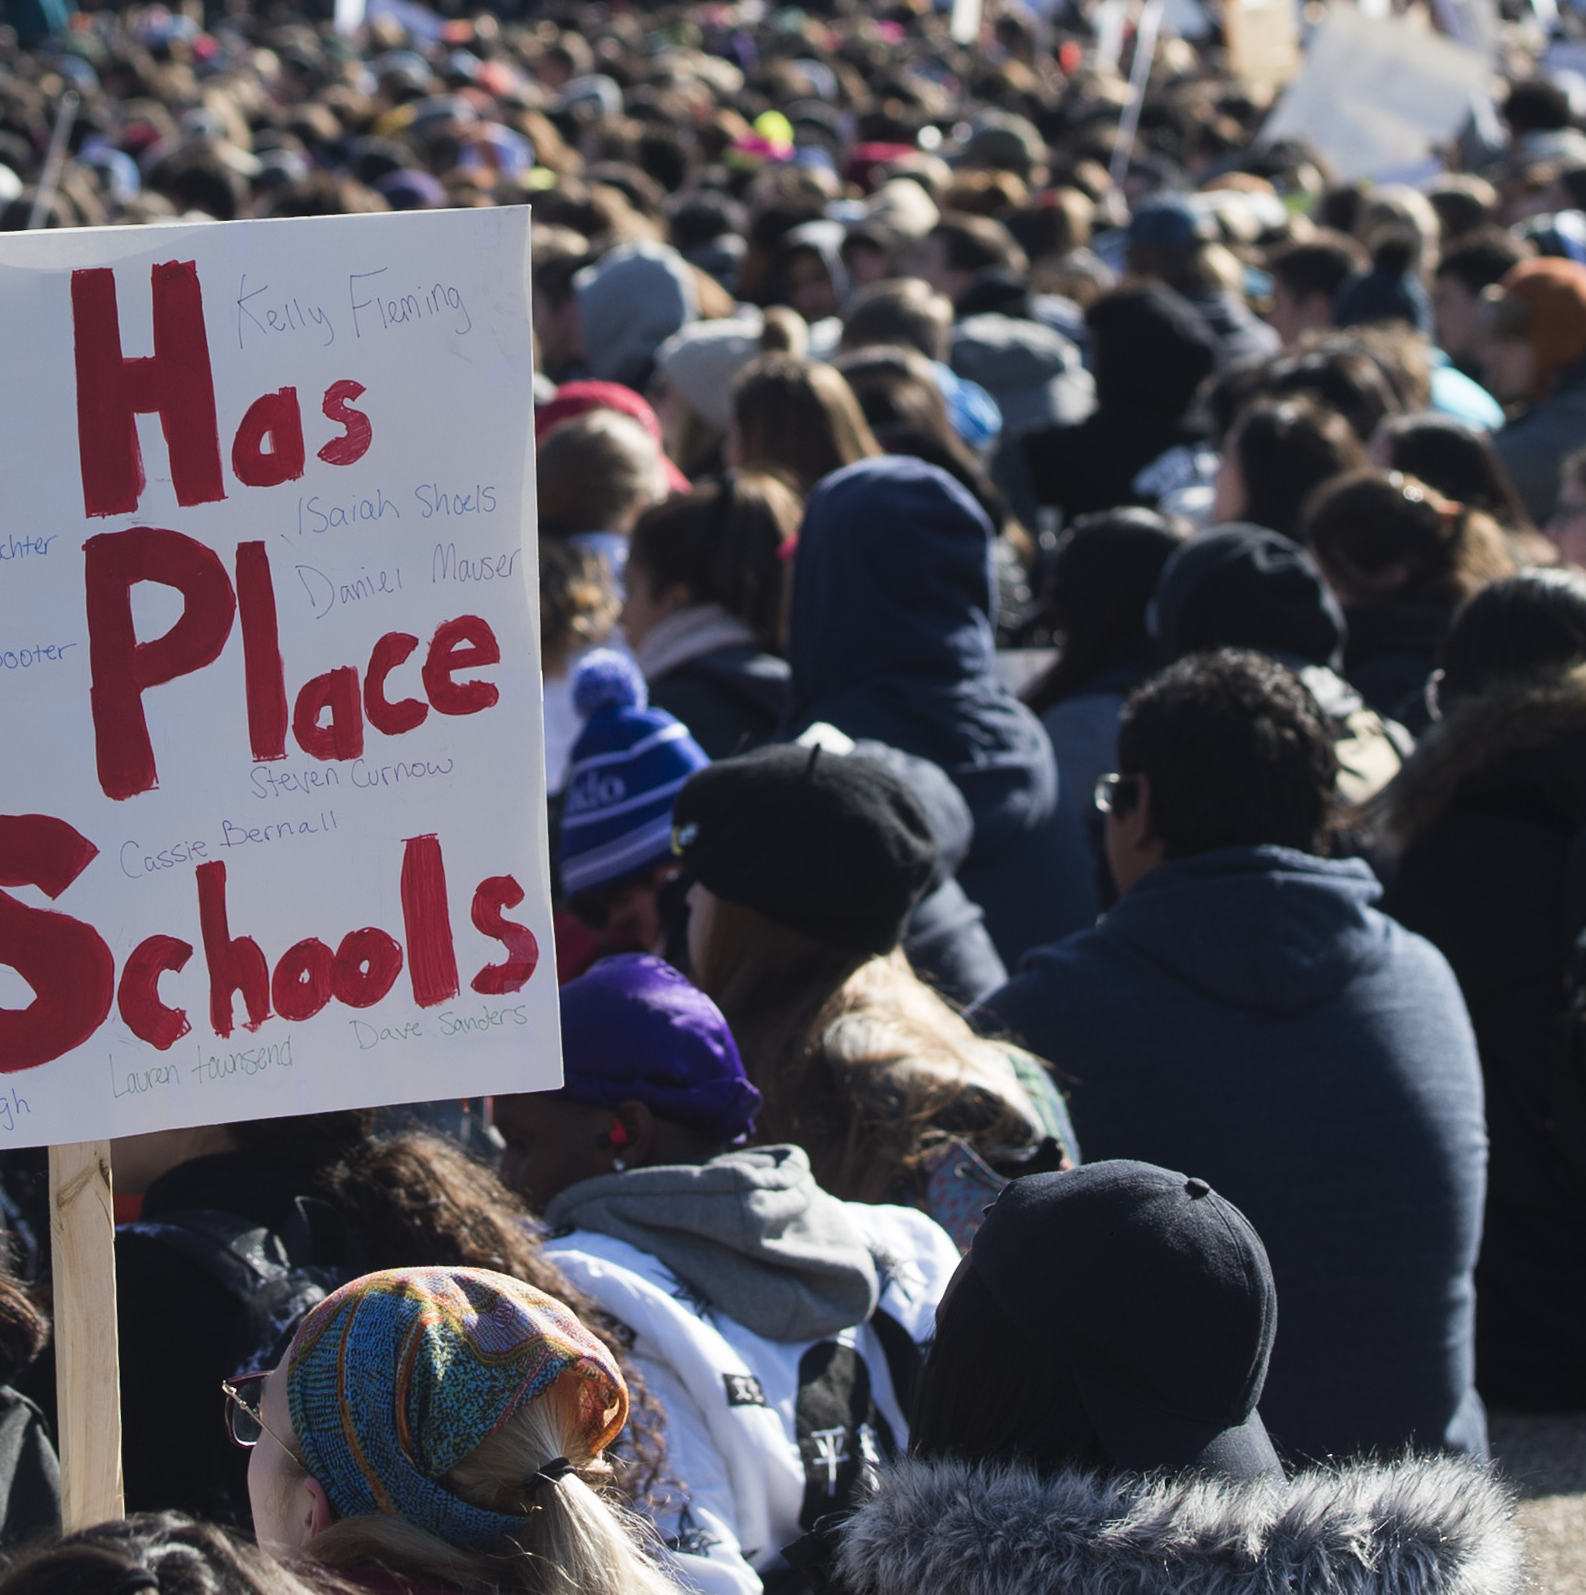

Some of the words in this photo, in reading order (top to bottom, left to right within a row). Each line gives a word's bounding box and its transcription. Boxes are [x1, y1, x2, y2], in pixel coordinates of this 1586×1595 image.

[236, 273, 335, 350] Kelly
[349, 266, 472, 338] Fleming
[71, 259, 372, 518] Has
[294, 564, 403, 620] Daniel
[432, 542, 522, 583] Mauser
[82, 526, 501, 802] Place
[249, 765, 340, 799] Steven
[351, 757, 455, 789] Curnow
[119, 839, 209, 879] Cassie
[219, 809, 338, 848] Bernall
[349, 1019, 423, 1050] Dave
[438, 1004, 529, 1036] Sanders
[108, 1053, 180, 1099] Lauren
